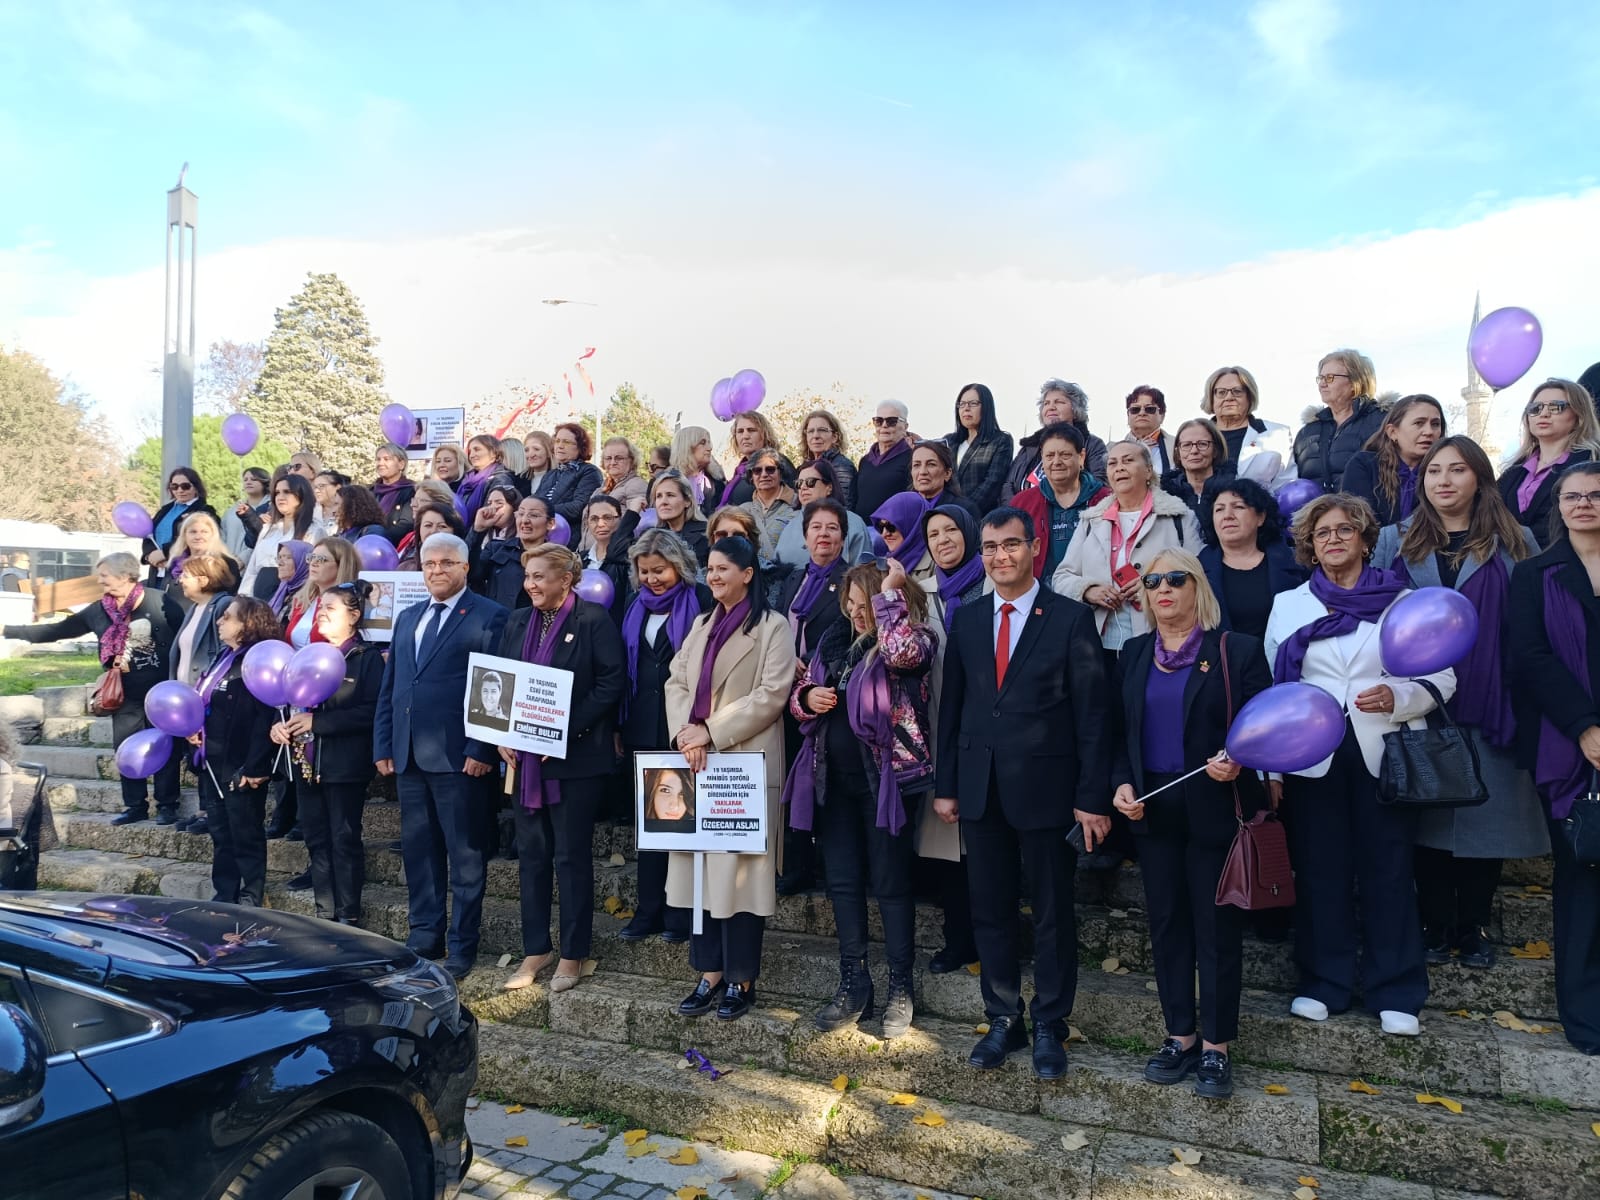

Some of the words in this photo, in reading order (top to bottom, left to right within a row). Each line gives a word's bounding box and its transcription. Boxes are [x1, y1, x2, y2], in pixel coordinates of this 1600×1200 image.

[536, 679, 557, 688] YAŞINDA
[526, 694, 557, 706] TARAFINDAN
[516, 723, 537, 735] EMİNE
[538, 727, 560, 739] BULUT
[732, 782, 757, 790] TECAVÜZE
[702, 820, 735, 830] ÖZGECAN
[735, 821, 759, 830] ASLAN
